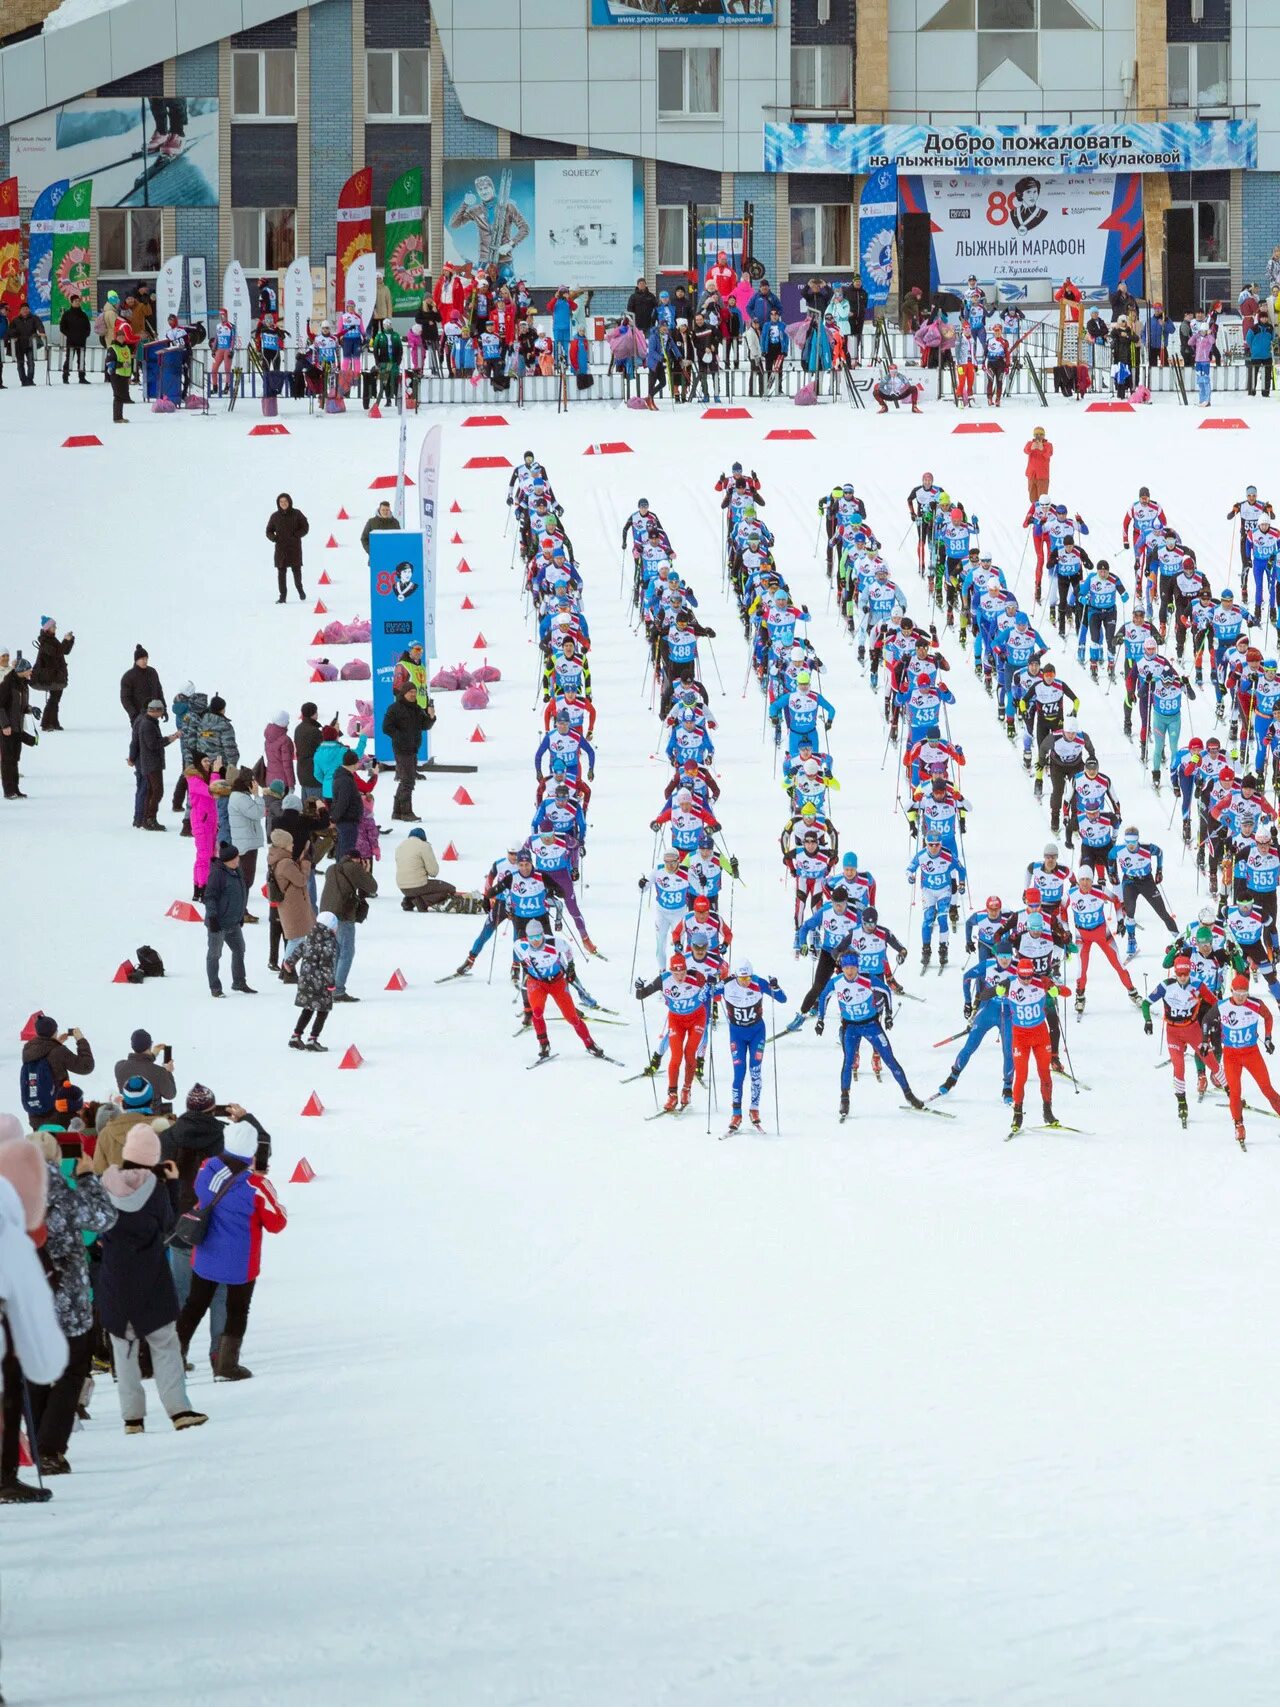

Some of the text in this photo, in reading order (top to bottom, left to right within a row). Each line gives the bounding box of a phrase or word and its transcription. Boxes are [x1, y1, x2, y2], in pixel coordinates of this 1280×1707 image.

[924, 134, 1132, 153] Добро пожаловать
[869, 150, 1181, 168] на лыжный комплекс Г. А. Кулаковой
[562, 169, 601, 177] SQUEEZY
[955, 237, 1085, 256] ЛЫЖНЫЙ МАРАФОН
[1021, 285, 1028, 297] 1
[647, 561, 658, 571] 58
[672, 645, 691, 657] 488
[1130, 643, 1143, 653] 37
[1042, 703, 1060, 714] 474
[1159, 698, 1178, 710] 558
[916, 709, 934, 721] 433
[930, 821, 950, 833] 556
[676, 832, 697, 844] 454
[928, 874, 946, 884] 451
[1253, 873, 1274, 885] 553
[519, 896, 542, 910] 441
[660, 891, 682, 903] 438
[1034, 959, 1048, 972] 13
[734, 1008, 756, 1022] 514
[1017, 1003, 1040, 1018] 580
[1229, 1030, 1252, 1044] 516
